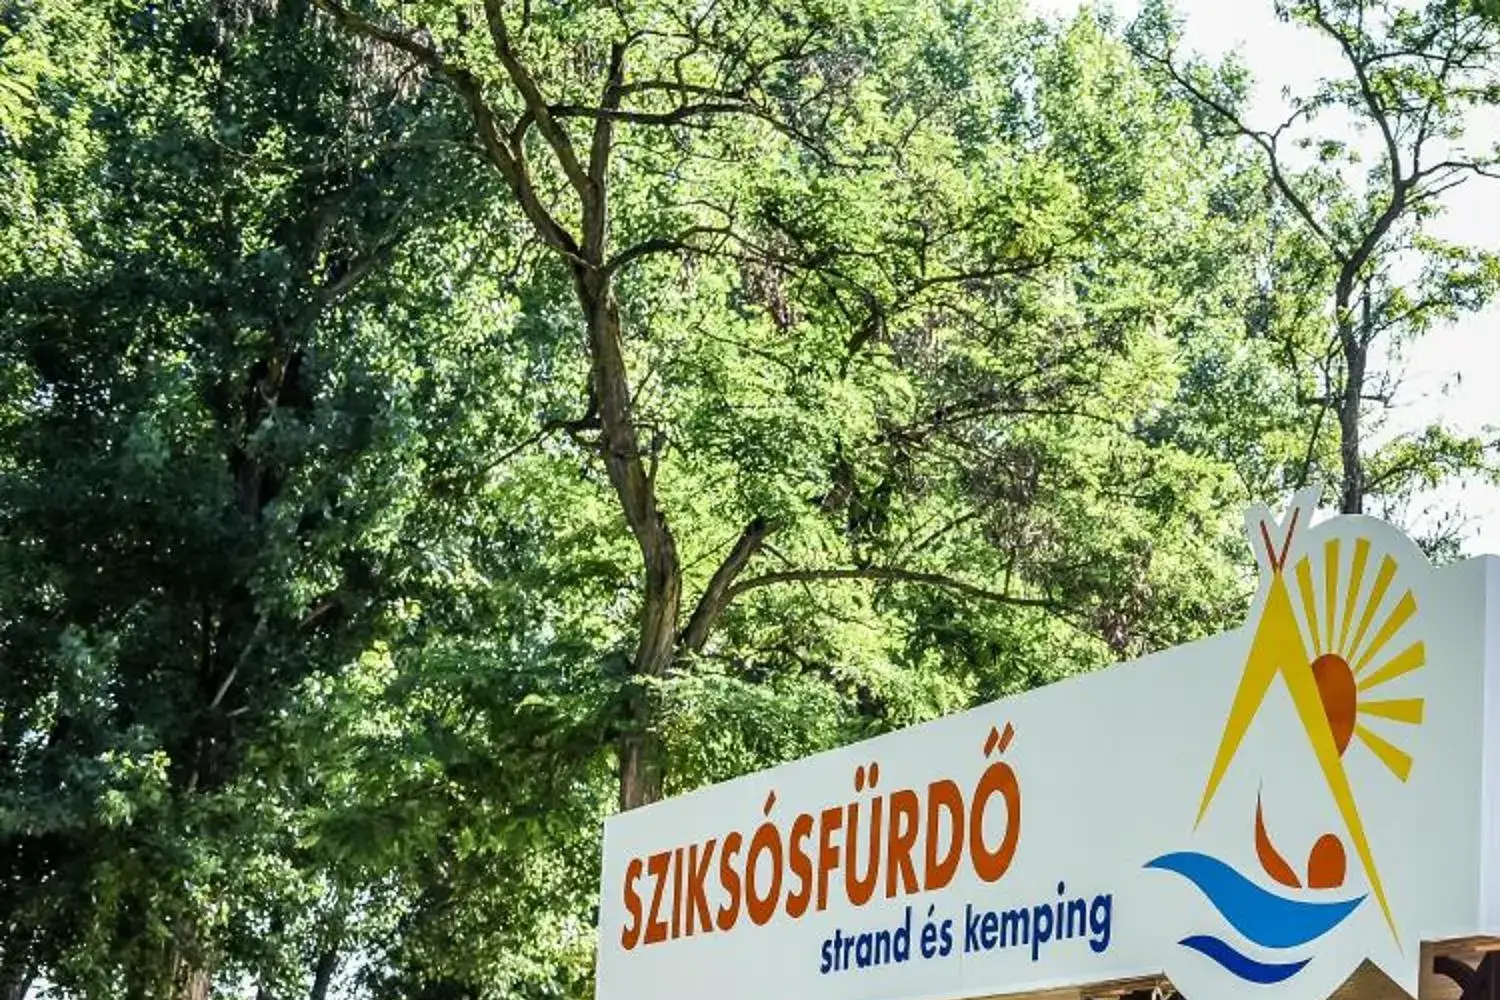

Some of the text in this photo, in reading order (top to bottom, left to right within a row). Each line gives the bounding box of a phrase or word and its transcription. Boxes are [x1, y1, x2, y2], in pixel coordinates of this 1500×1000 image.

[621, 722, 1021, 951] SZIKSÓSFÜRDŐ
[819, 880, 1114, 975] strand és kemping
